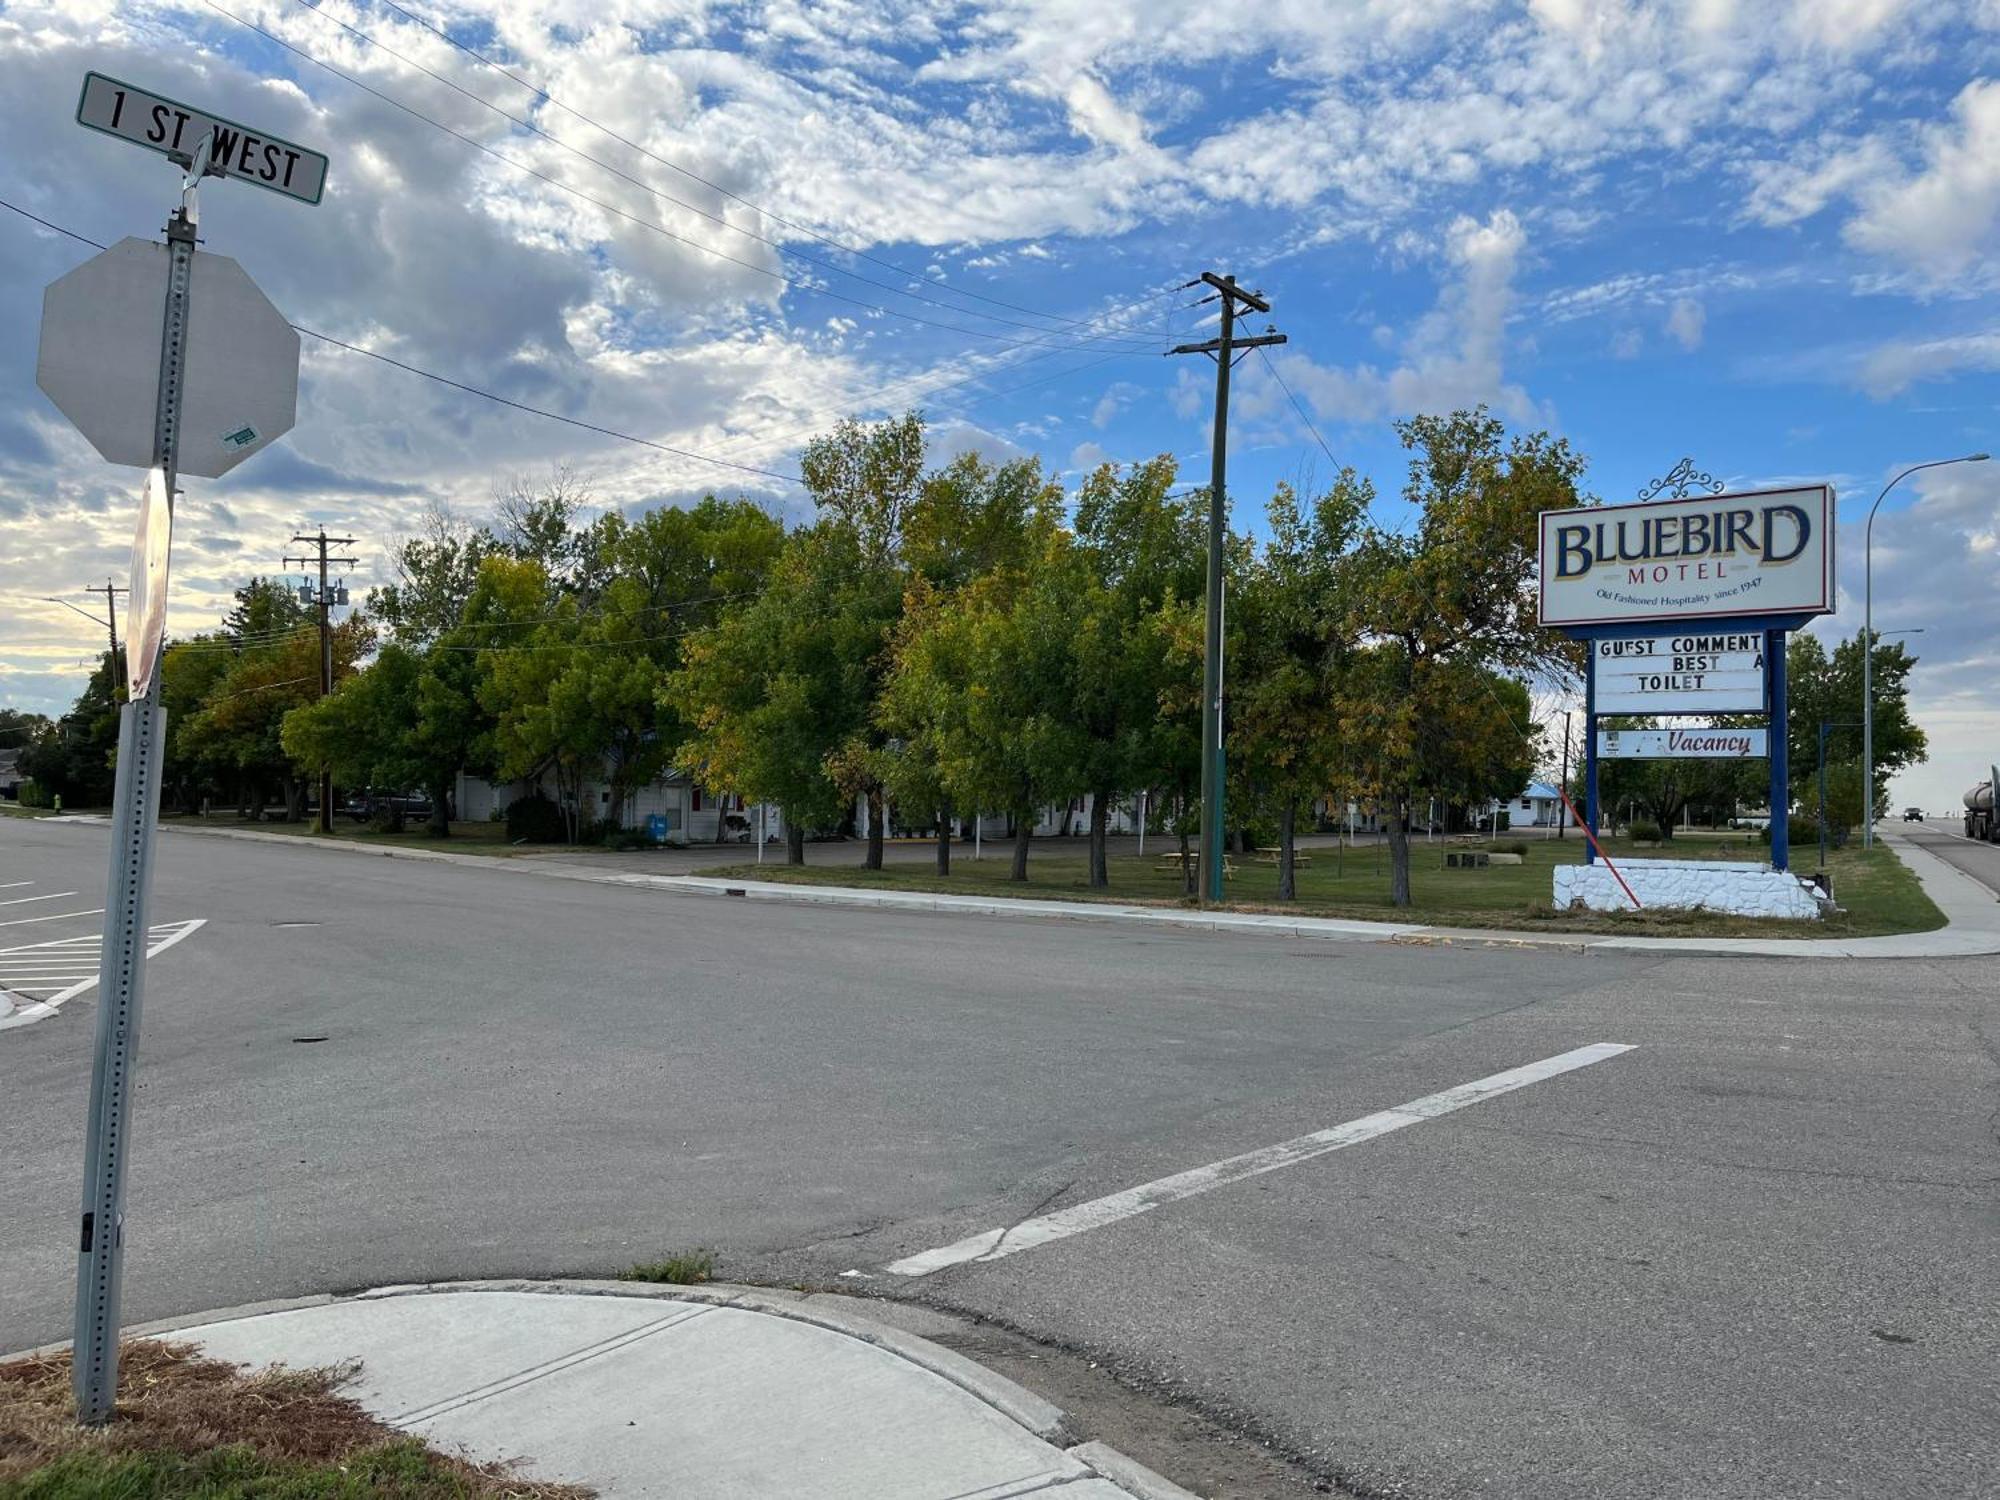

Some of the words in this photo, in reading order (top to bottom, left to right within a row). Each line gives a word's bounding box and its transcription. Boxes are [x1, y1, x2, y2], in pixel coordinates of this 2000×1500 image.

[109, 91, 125, 128] 1
[147, 104, 190, 150] ST
[209, 124, 300, 188] WEST
[1554, 505, 1811, 581] BLUEBIRD
[1628, 562, 1727, 585] MOTEL
[1597, 588, 1613, 600] Old
[1614, 592, 1658, 606] Fashioned
[1660, 594, 1710, 606] Hospitality
[1714, 588, 1738, 600] since
[1740, 576, 1763, 592] 1947
[1600, 639, 1656, 657] GUEST
[1671, 635, 1761, 653] COMMENT
[1673, 656, 1719, 671] BEST
[1753, 654, 1764, 669] A
[1639, 675, 1705, 690] TOILET
[1668, 731, 1751, 756] Vacancy
